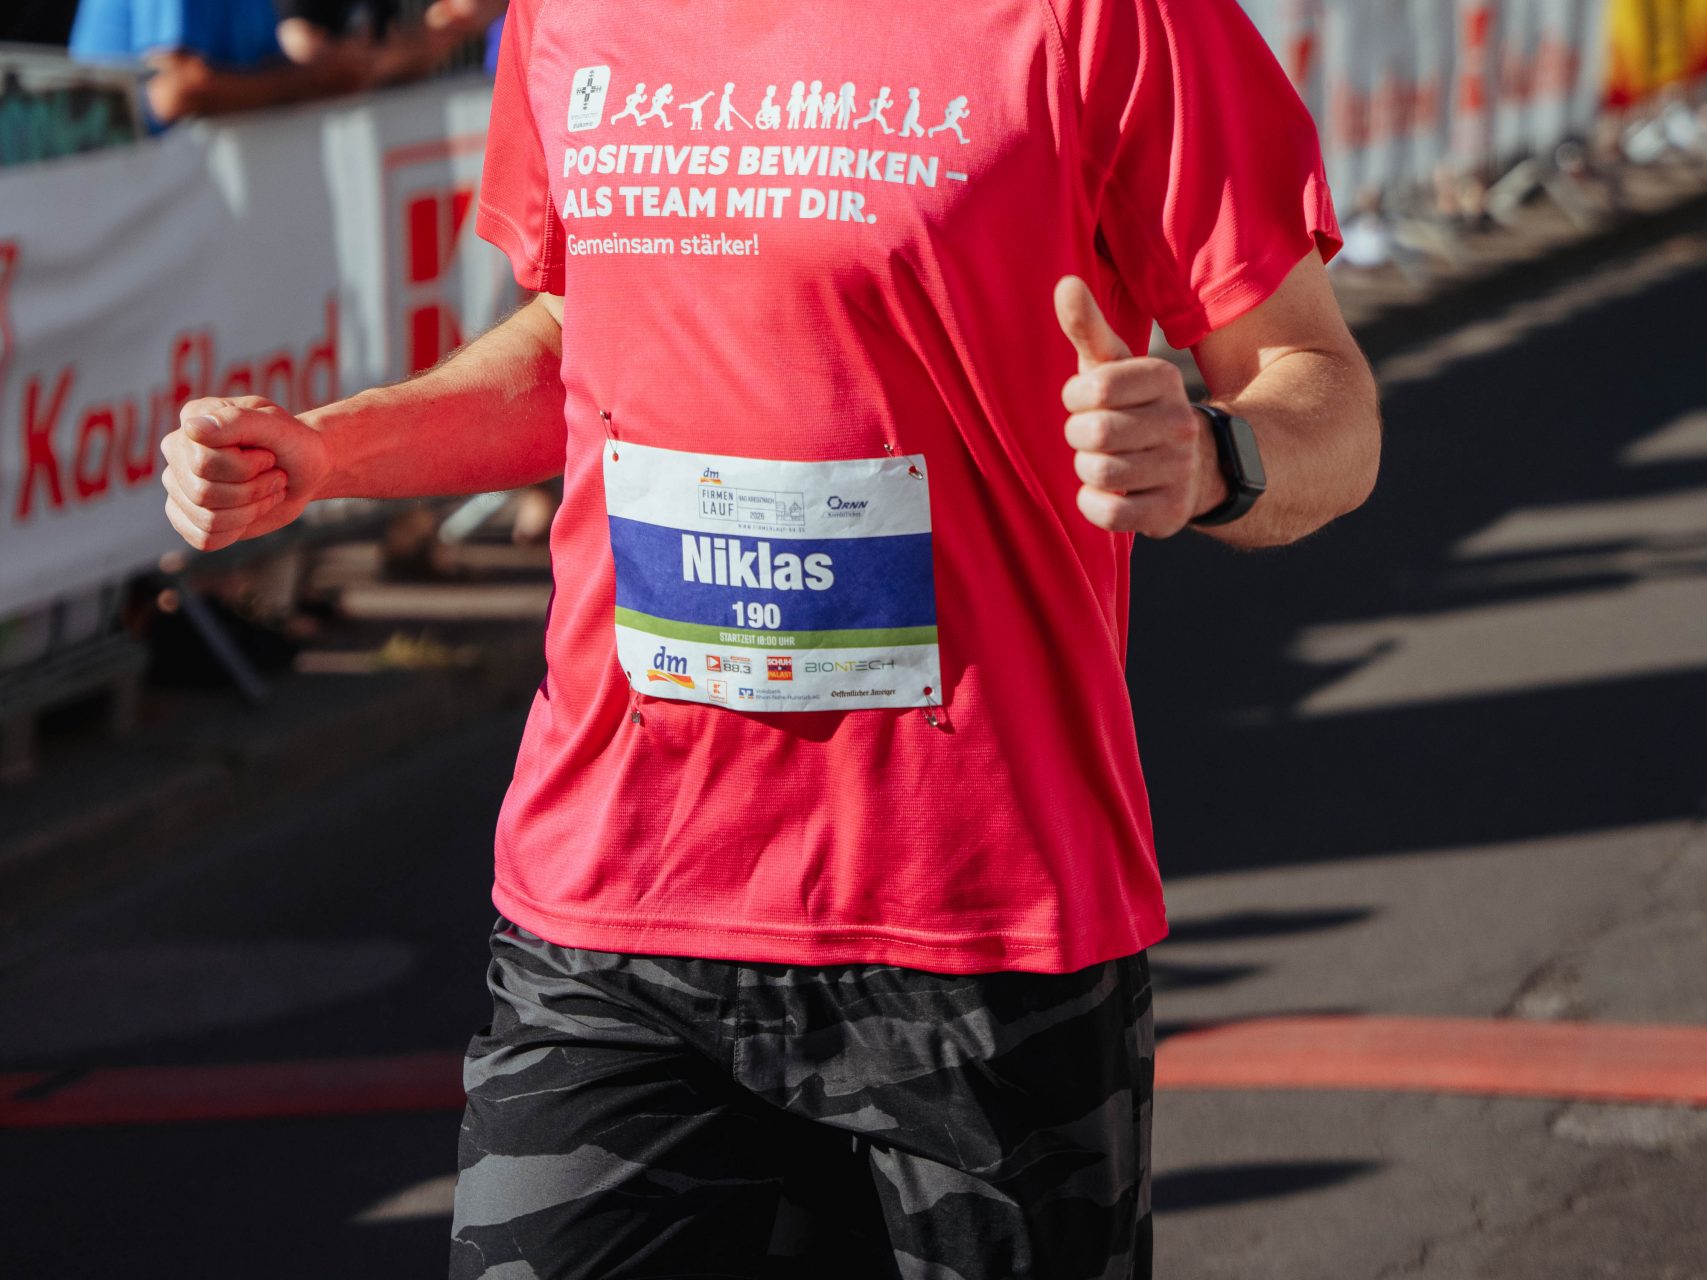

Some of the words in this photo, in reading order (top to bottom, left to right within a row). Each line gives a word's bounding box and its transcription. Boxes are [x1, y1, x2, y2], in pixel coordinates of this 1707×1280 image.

[563, 144, 731, 178] POSITIVES
[736, 144, 939, 188] BEWIRKEN
[561, 186, 613, 220] ALS
[618, 186, 718, 218] TEAM
[725, 187, 793, 219] MIT
[798, 188, 878, 225] DIR.
[567, 232, 675, 256] Gemeinsam
[680, 231, 760, 256] stärker!
[703, 467, 720, 480] dm
[702, 489, 734, 501] FIRMEN
[702, 501, 734, 517] LAUF
[681, 533, 835, 591] Niklas
[732, 601, 782, 630] 190
[719, 632, 756, 646] STARTZEIT
[779, 635, 796, 646] UHR
[653, 645, 688, 675] dm
[723, 663, 752, 675] 88.3
[805, 659, 895, 673] BIONTECH
